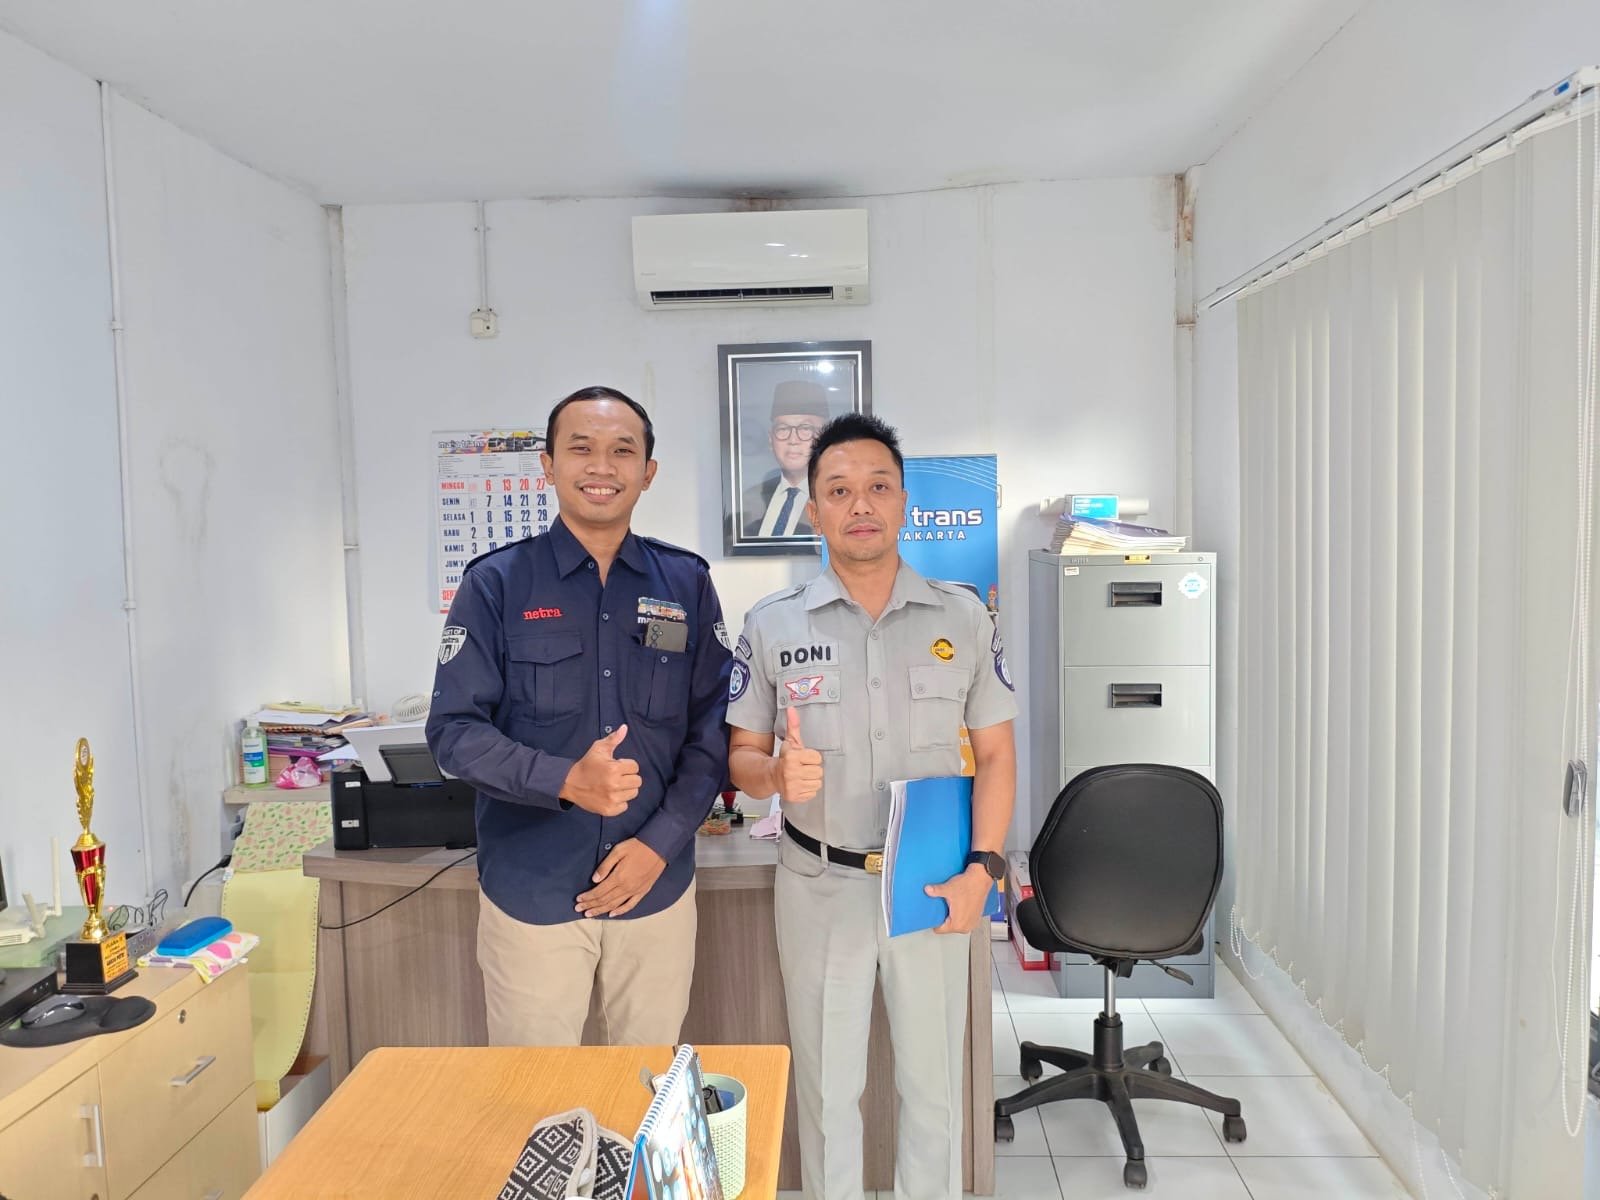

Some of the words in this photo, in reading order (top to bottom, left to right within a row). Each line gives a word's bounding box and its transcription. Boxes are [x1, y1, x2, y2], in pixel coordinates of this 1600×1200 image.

[441, 482, 465, 490] MINGGU
[485, 479, 491, 491] 6
[503, 478, 511, 491] 13
[520, 478, 529, 491] 20
[536, 478, 545, 490] 27
[442, 498, 460, 506] SENIN
[487, 495, 492, 507] 7
[503, 494, 513, 507] 14
[520, 494, 529, 506] 21
[537, 494, 547, 506] 28
[443, 513, 466, 521] SELASA
[470, 511, 474, 523] 1
[487, 511, 492, 523] 8
[504, 510, 512, 522] 15
[520, 510, 531, 522] 22
[537, 509, 548, 522] 29
[911, 506, 983, 527] trans
[444, 529, 460, 537] RABU
[471, 526, 477, 539] 2
[488, 526, 493, 538] 9
[505, 526, 513, 538] 16
[522, 525, 532, 537] 23
[898, 530, 966, 541] AKARTA
[444, 544, 465, 552] KAMIS
[472, 542, 477, 555] 3
[489, 542, 497, 551] 10
[523, 607, 562, 620] netra
[780, 645, 831, 667] DONI
